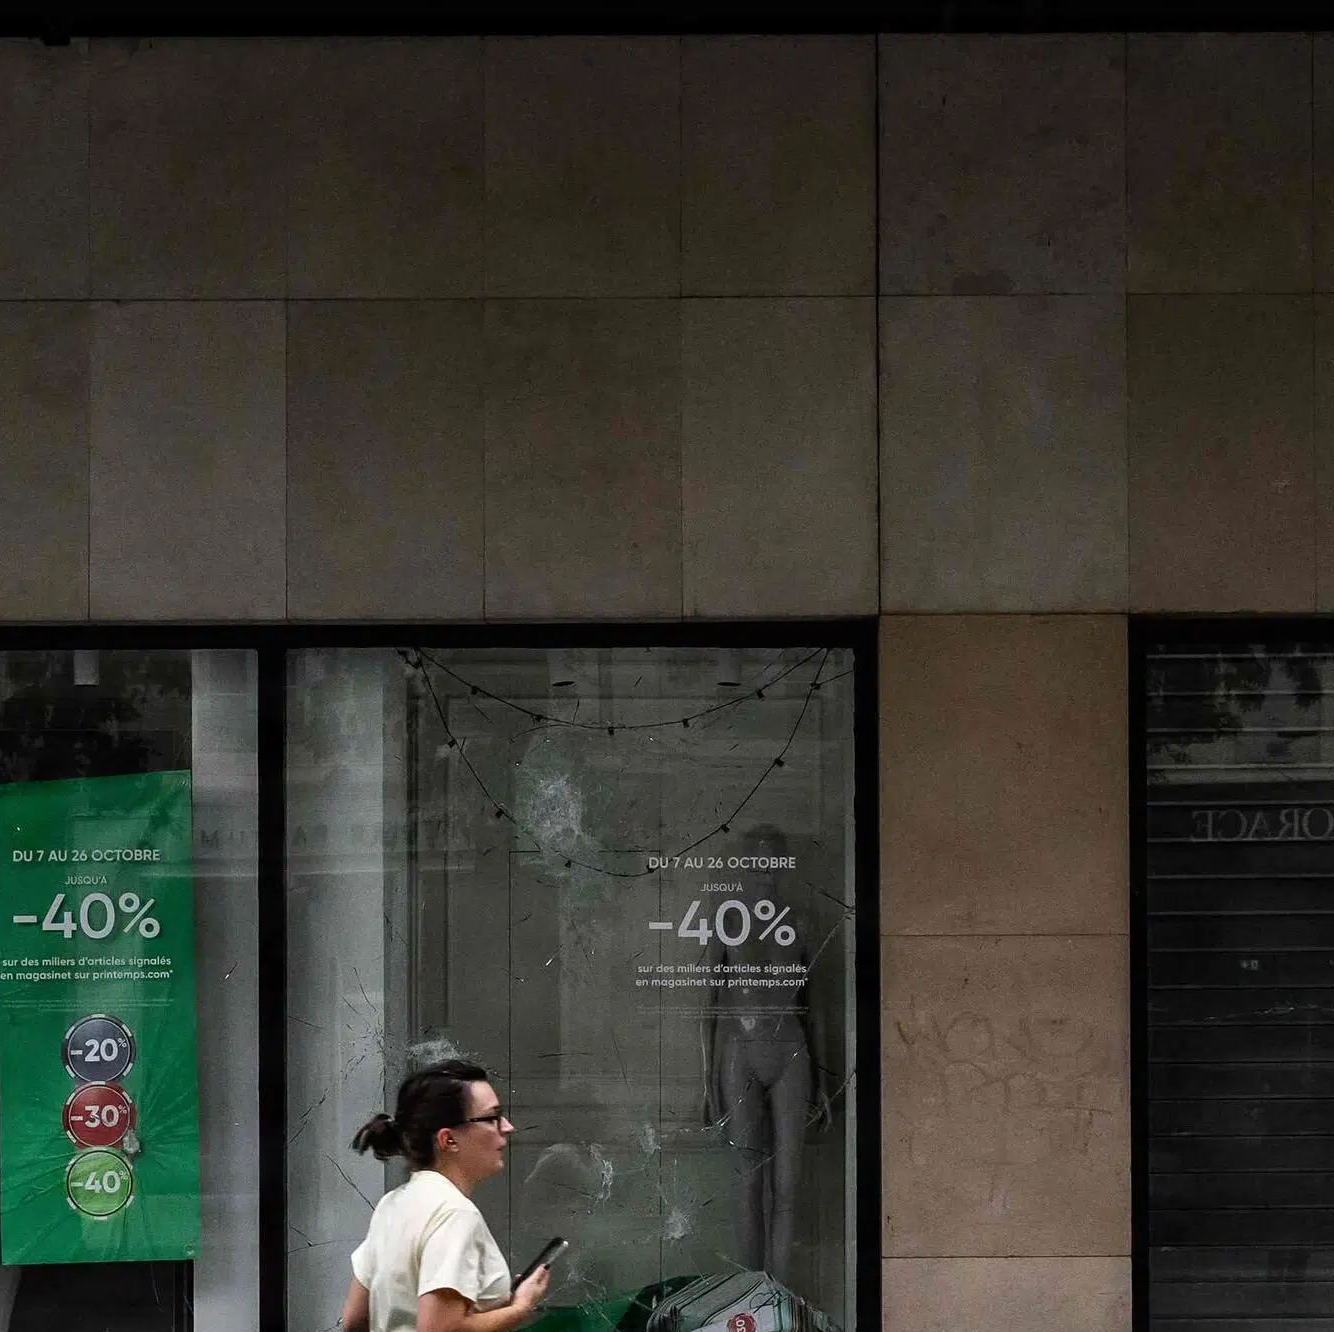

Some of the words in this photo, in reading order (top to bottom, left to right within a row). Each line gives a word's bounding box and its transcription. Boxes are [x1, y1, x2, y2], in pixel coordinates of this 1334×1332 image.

[13, 850, 33, 862] DU
[36, 850, 45, 862] 7
[48, 850, 68, 862] AU
[71, 850, 88, 862] 26
[91, 849, 161, 861] OCTOBRE
[648, 857, 669, 869] DU
[673, 857, 681, 869] 7
[684, 857, 704, 869] AU
[707, 857, 724, 869] 26
[728, 857, 796, 869] OCTOBRE
[13, 892, 161, 939] -40%
[648, 899, 796, 947] -40%
[2, 958, 18, 967] sur
[21, 956, 39, 967] des
[78, 956, 126, 967] d'articles
[128, 955, 172, 968] signalés
[637, 965, 653, 973] sur
[656, 963, 675, 973] des
[713, 963, 761, 973] d'articles
[764, 963, 807, 975] signalés
[0, 972, 14, 980] en
[74, 971, 91, 980] sur
[635, 978, 649, 987] en
[709, 978, 726, 987] sur
